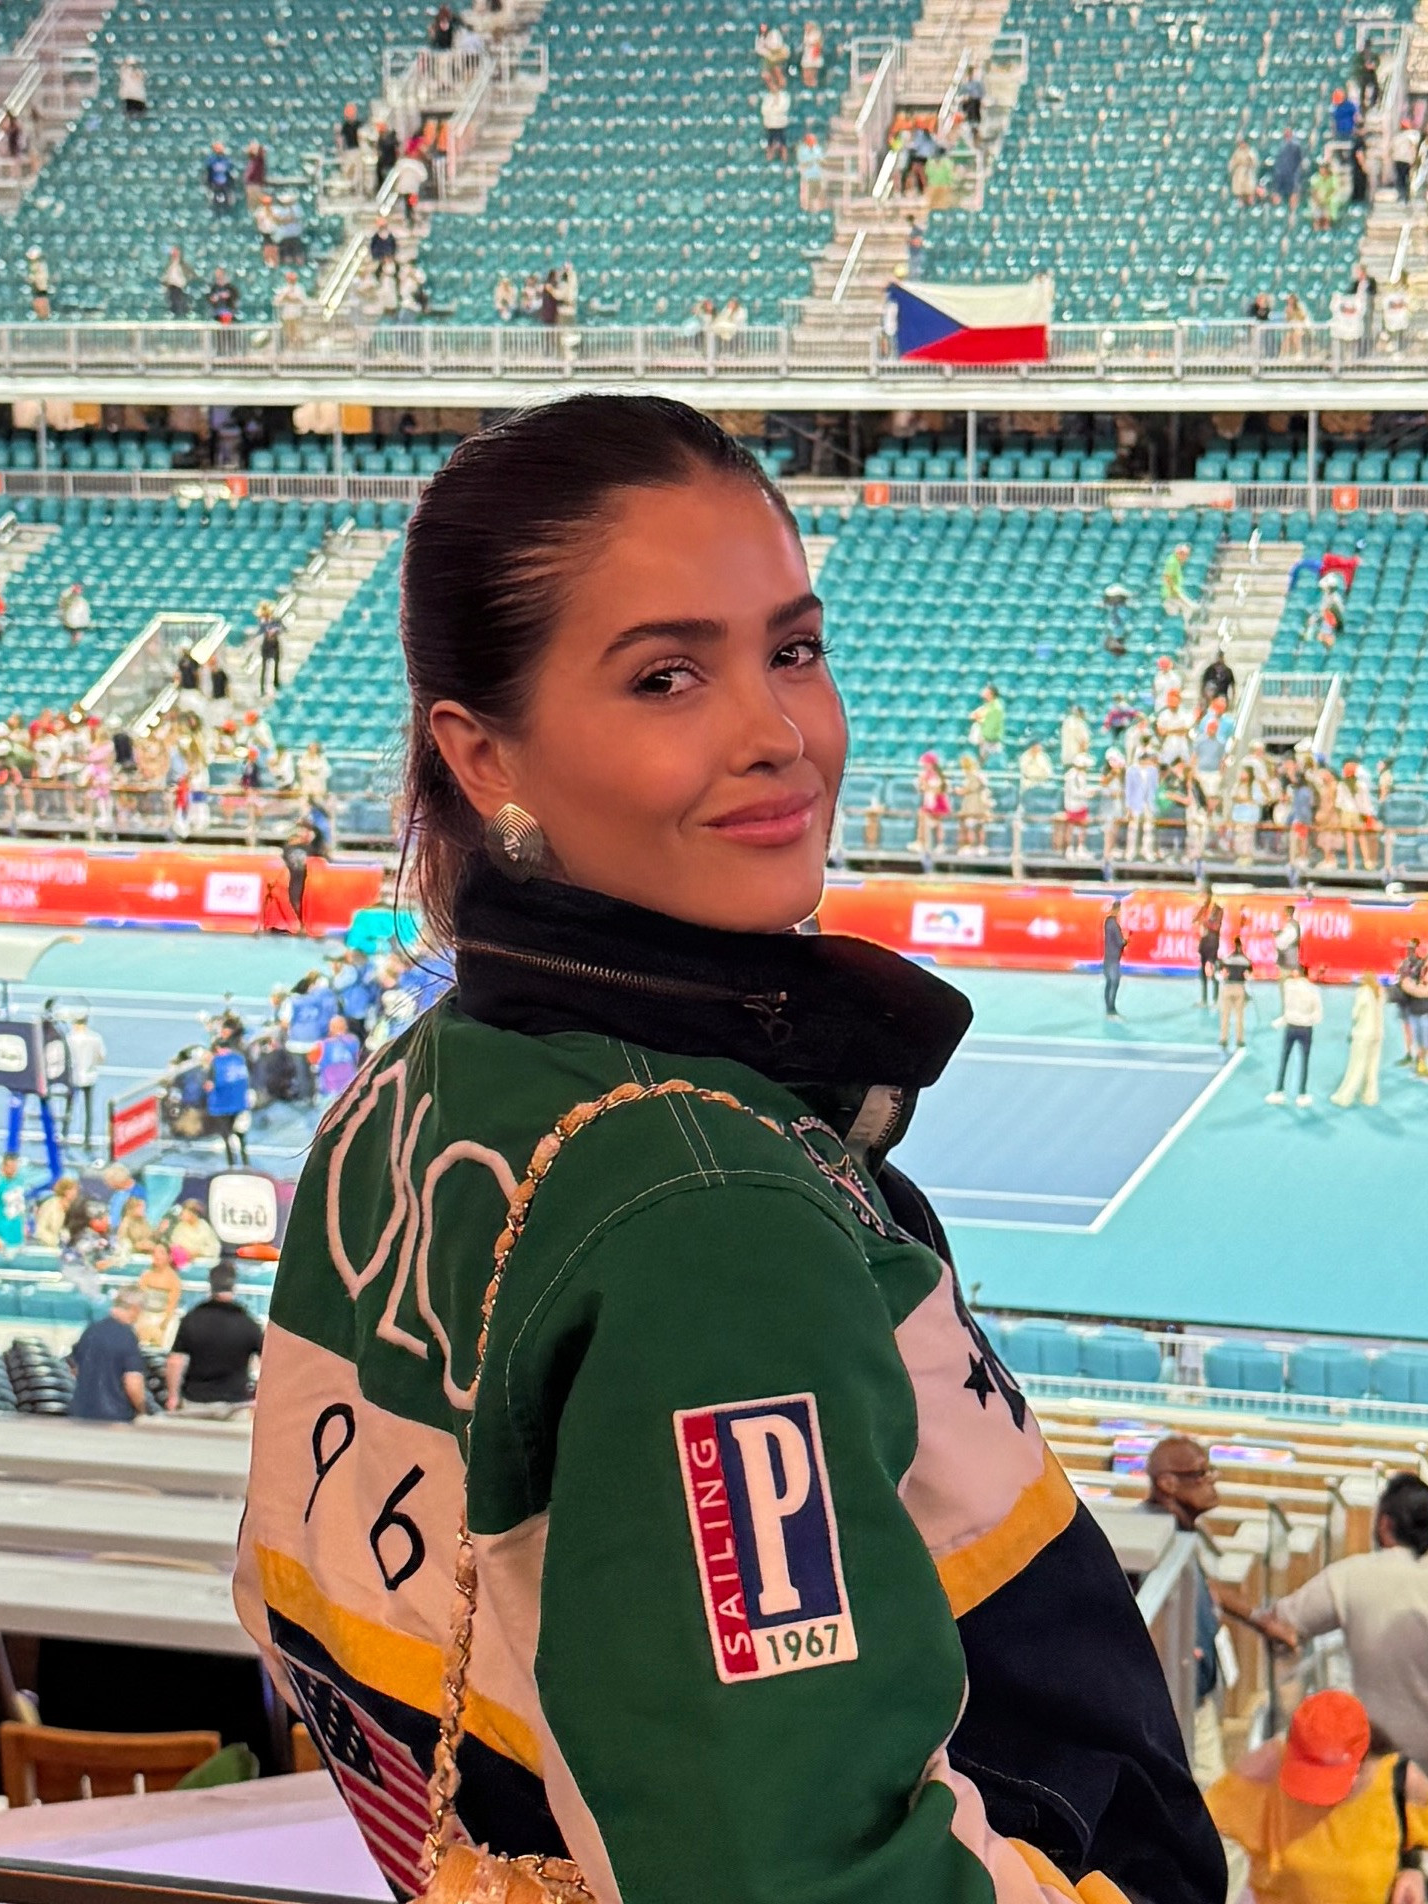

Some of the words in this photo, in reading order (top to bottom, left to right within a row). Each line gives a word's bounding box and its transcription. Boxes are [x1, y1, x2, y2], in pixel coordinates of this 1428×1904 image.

[691, 1435, 752, 1656] SAILING
[729, 1413, 811, 1617] P
[766, 1622, 839, 1666] 1967
